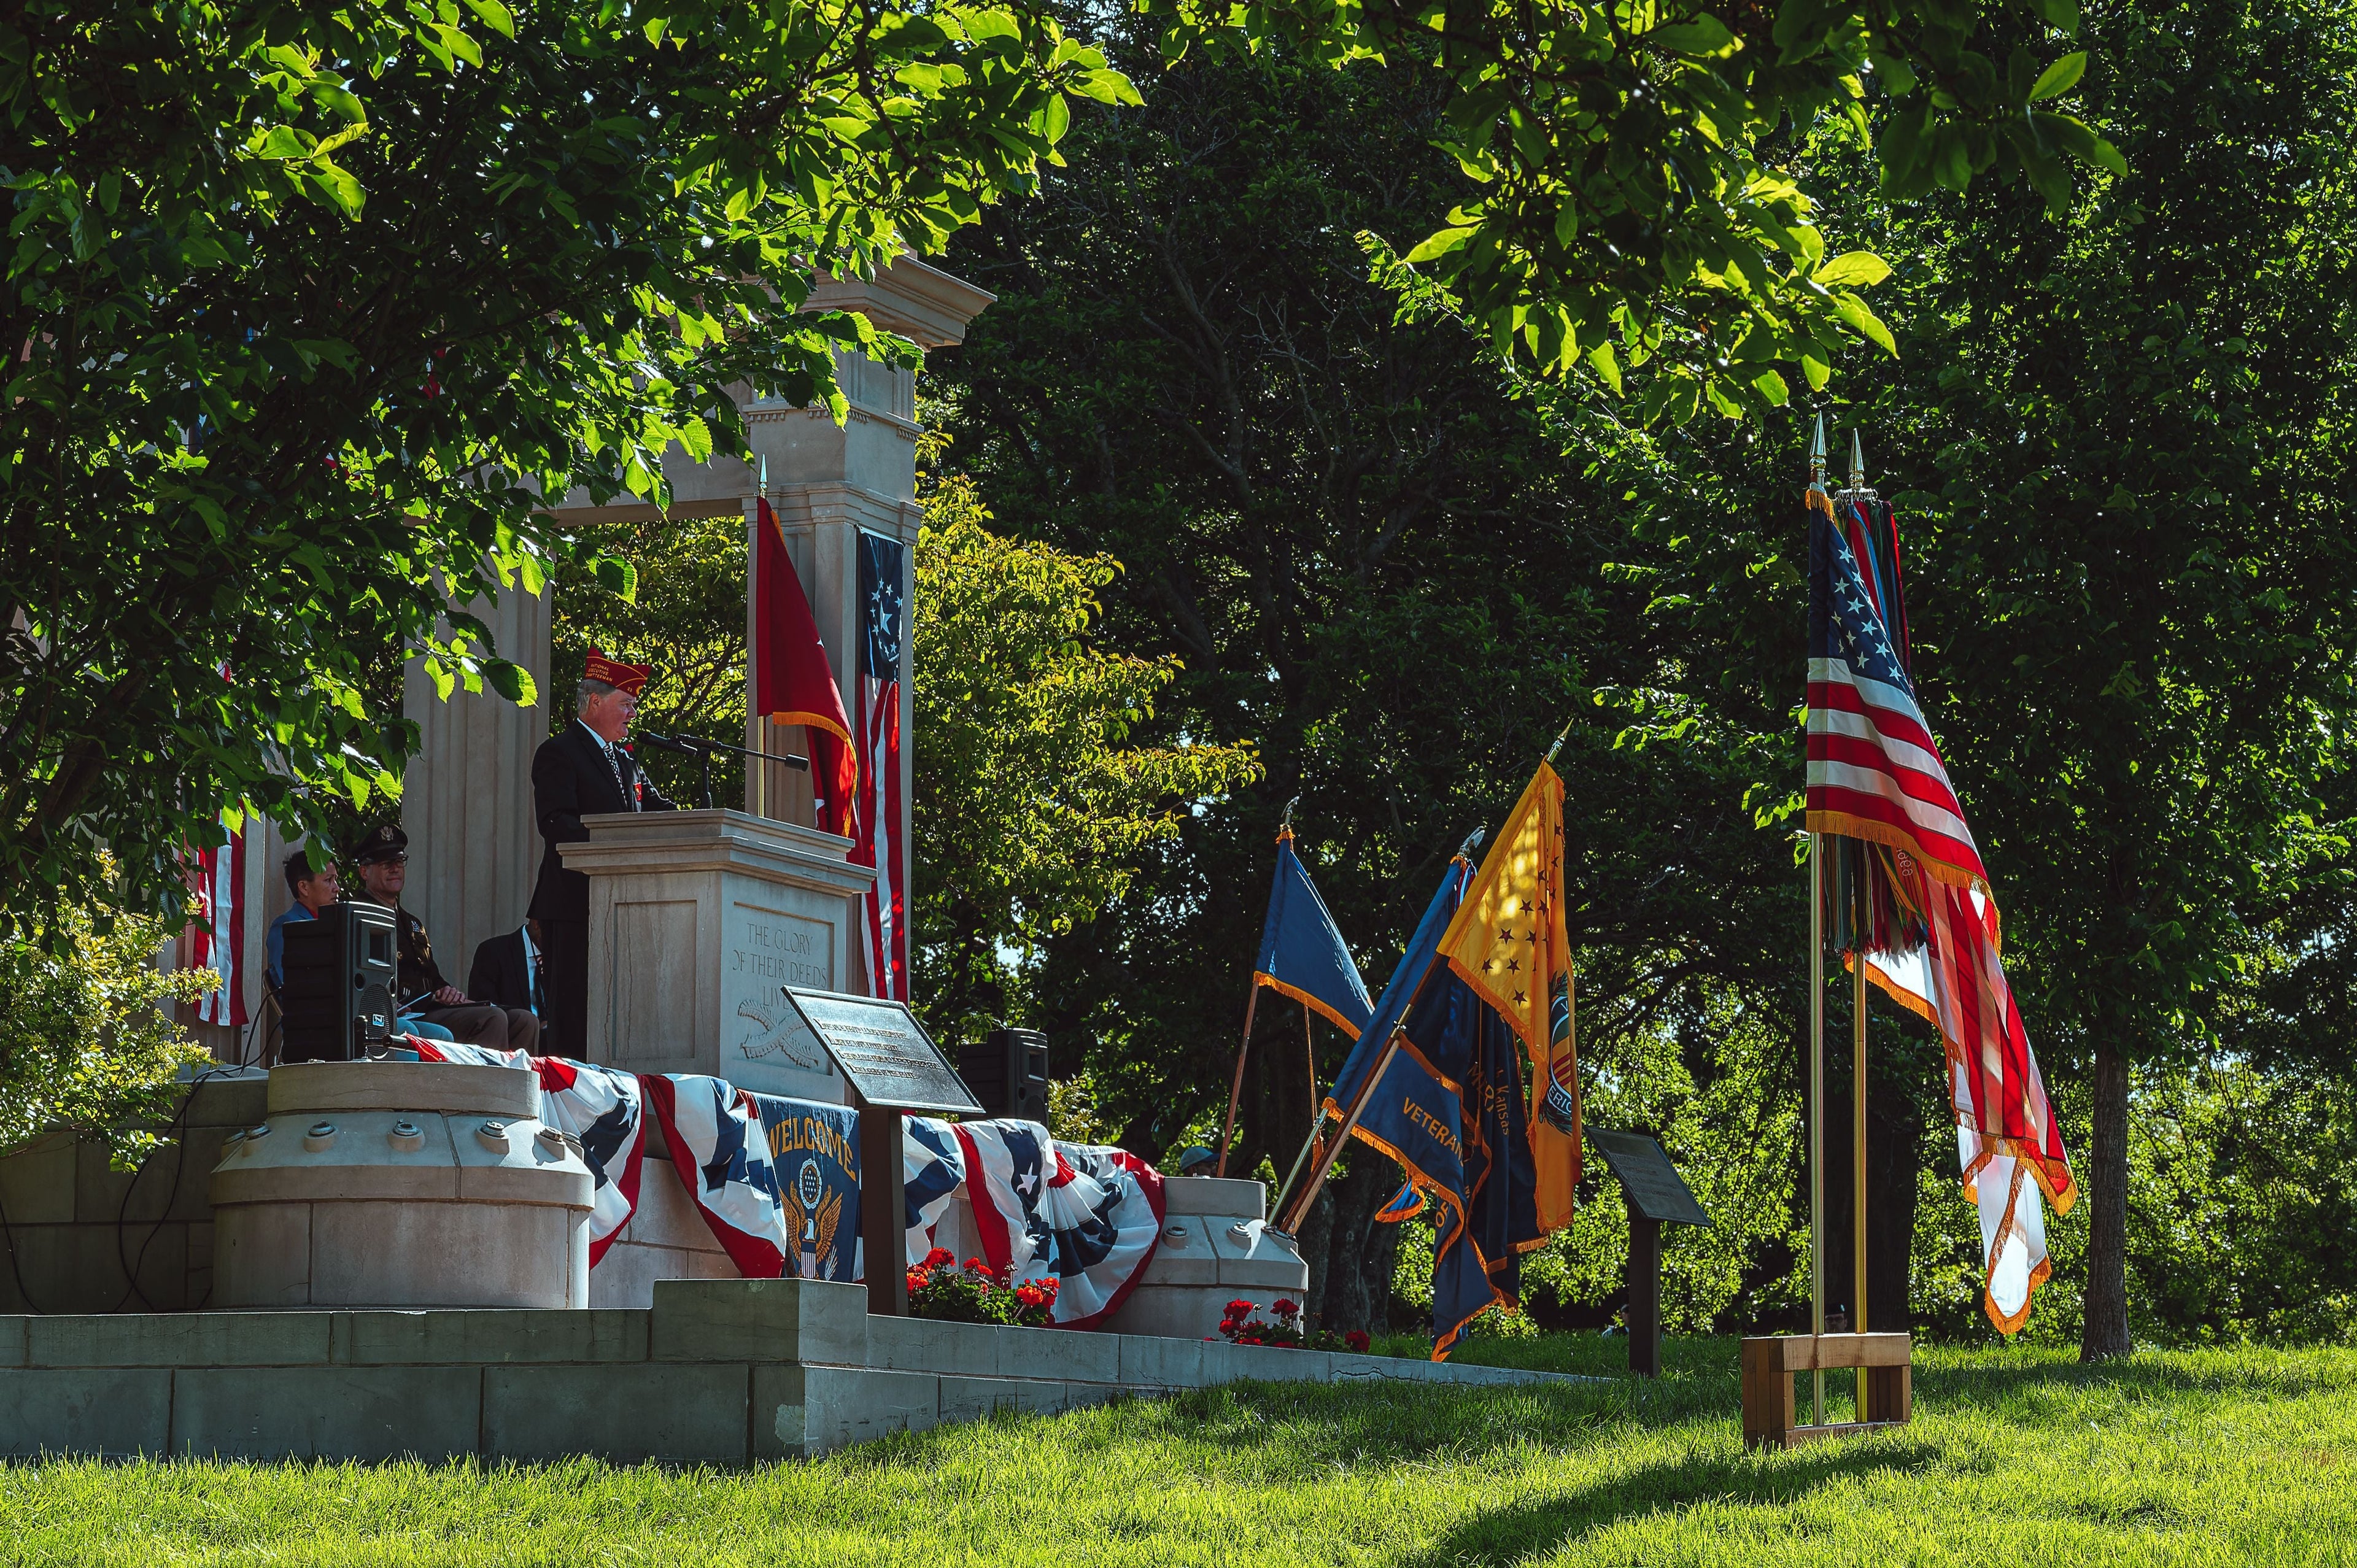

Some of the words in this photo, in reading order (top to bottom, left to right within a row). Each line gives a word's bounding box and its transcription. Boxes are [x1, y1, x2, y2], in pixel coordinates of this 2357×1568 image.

[747, 922, 770, 947] THE
[774, 929, 813, 956] GLORY
[751, 952, 786, 980] THEIR
[790, 961, 827, 988] DEEDS
[1403, 1096, 1464, 1167] VETERAN
[1496, 1084, 1510, 1135] Kansas
[767, 1116, 856, 1182] WELCOME
